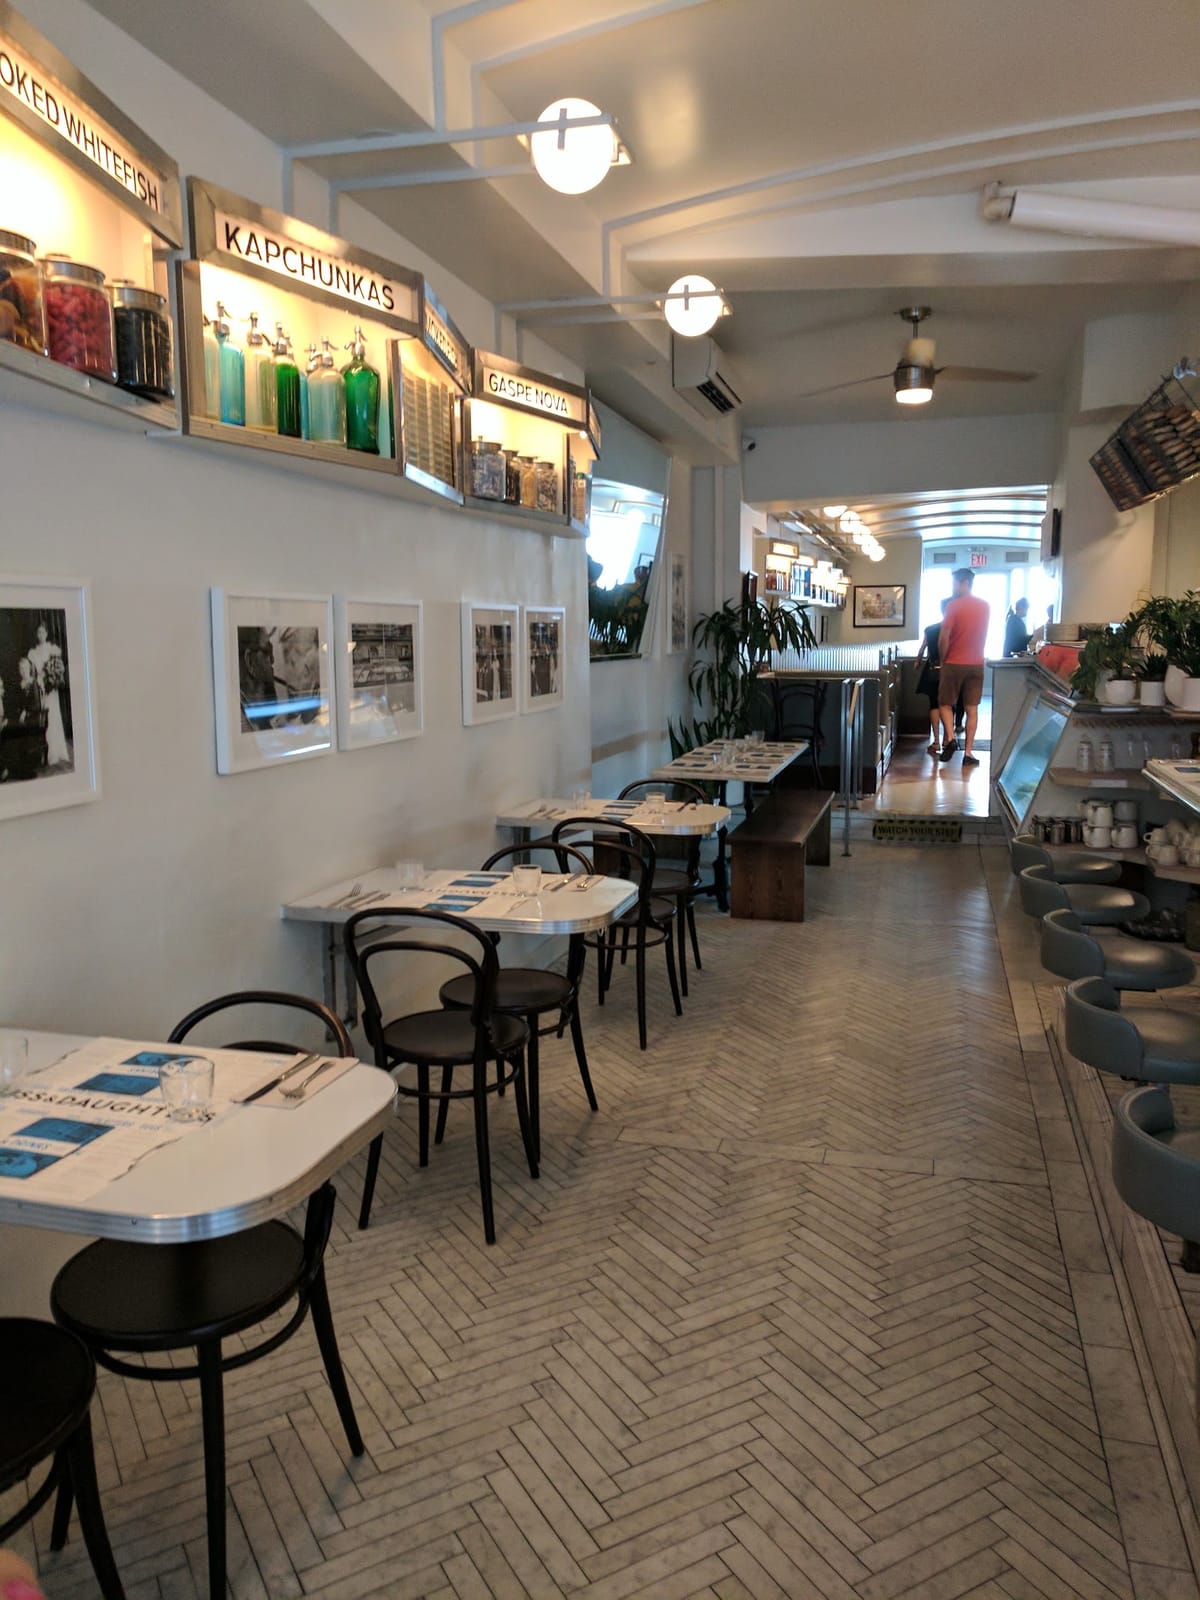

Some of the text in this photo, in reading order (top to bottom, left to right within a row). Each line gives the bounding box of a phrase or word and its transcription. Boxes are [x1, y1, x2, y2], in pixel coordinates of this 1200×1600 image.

[63, 105, 159, 212] WHITEFISH
[225, 221, 395, 311] KAPCHUNKAS
[488, 372, 569, 415] GASPE NOVA
[971, 552, 988, 567] EXIT
[877, 825, 908, 834] WATCH
